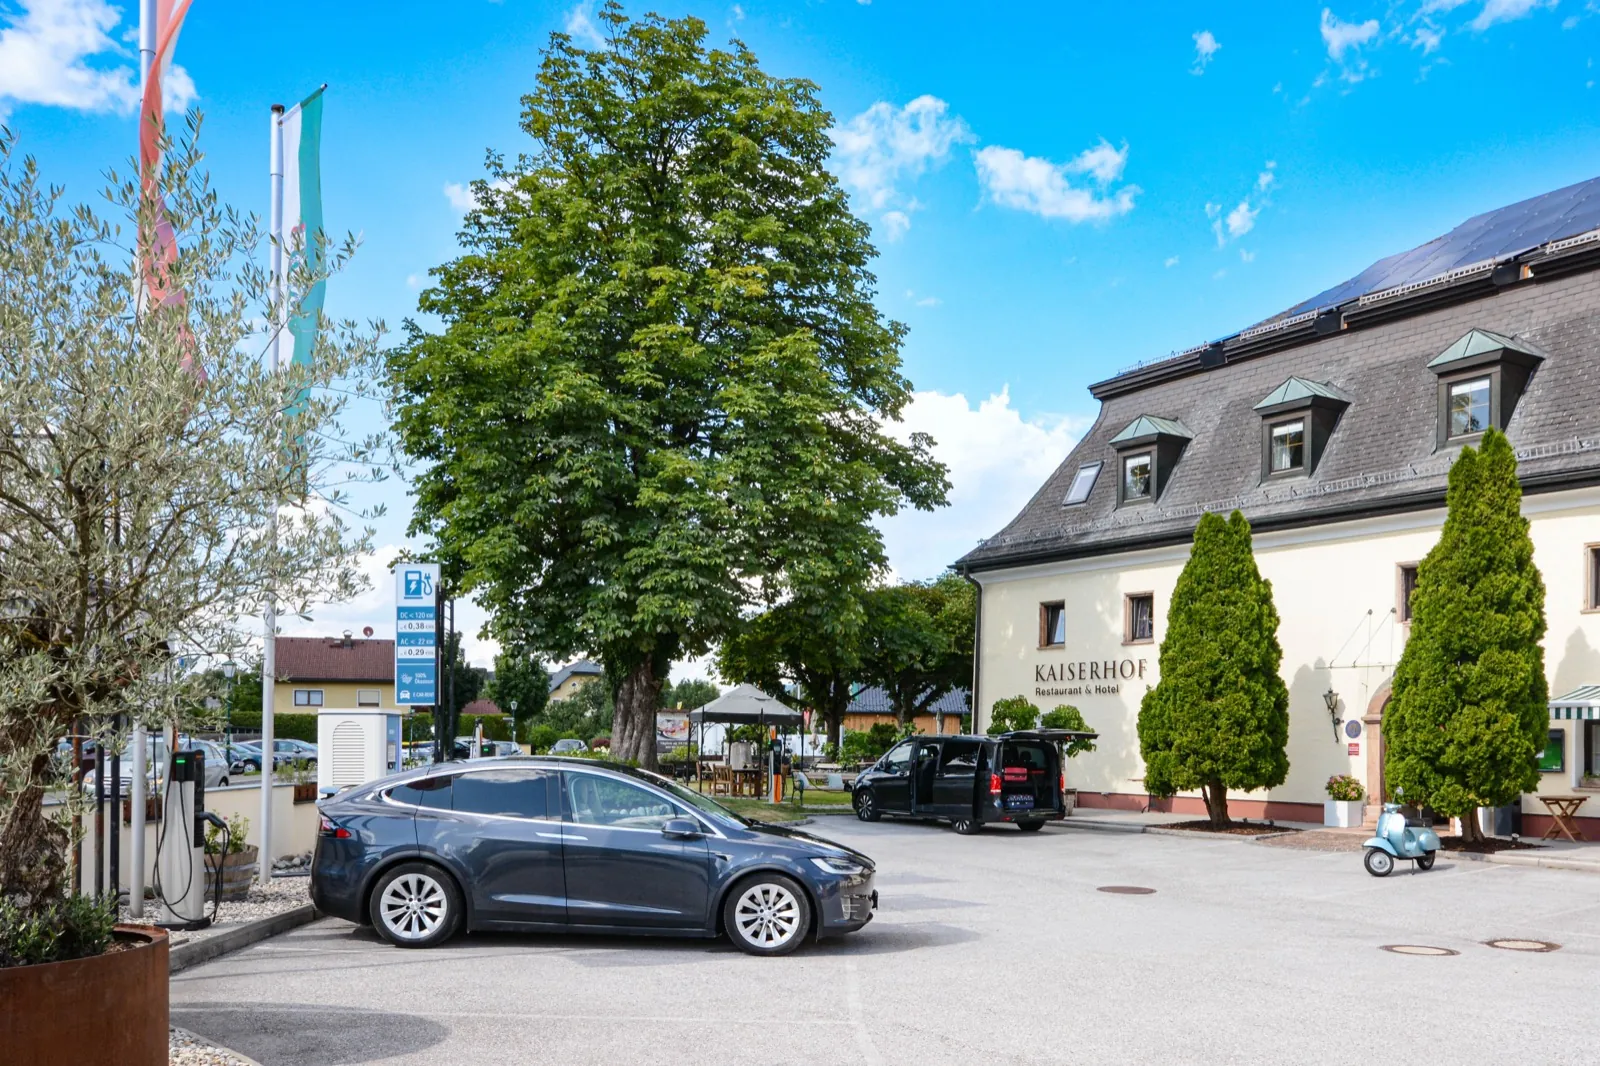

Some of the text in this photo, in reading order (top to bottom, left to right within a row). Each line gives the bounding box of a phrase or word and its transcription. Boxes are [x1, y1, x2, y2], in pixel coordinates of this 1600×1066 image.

[408, 622, 425, 630] 0,38
[1035, 658, 1148, 682] KAISERHOF
[1035, 684, 1119, 696] Restaurant & Hotel
